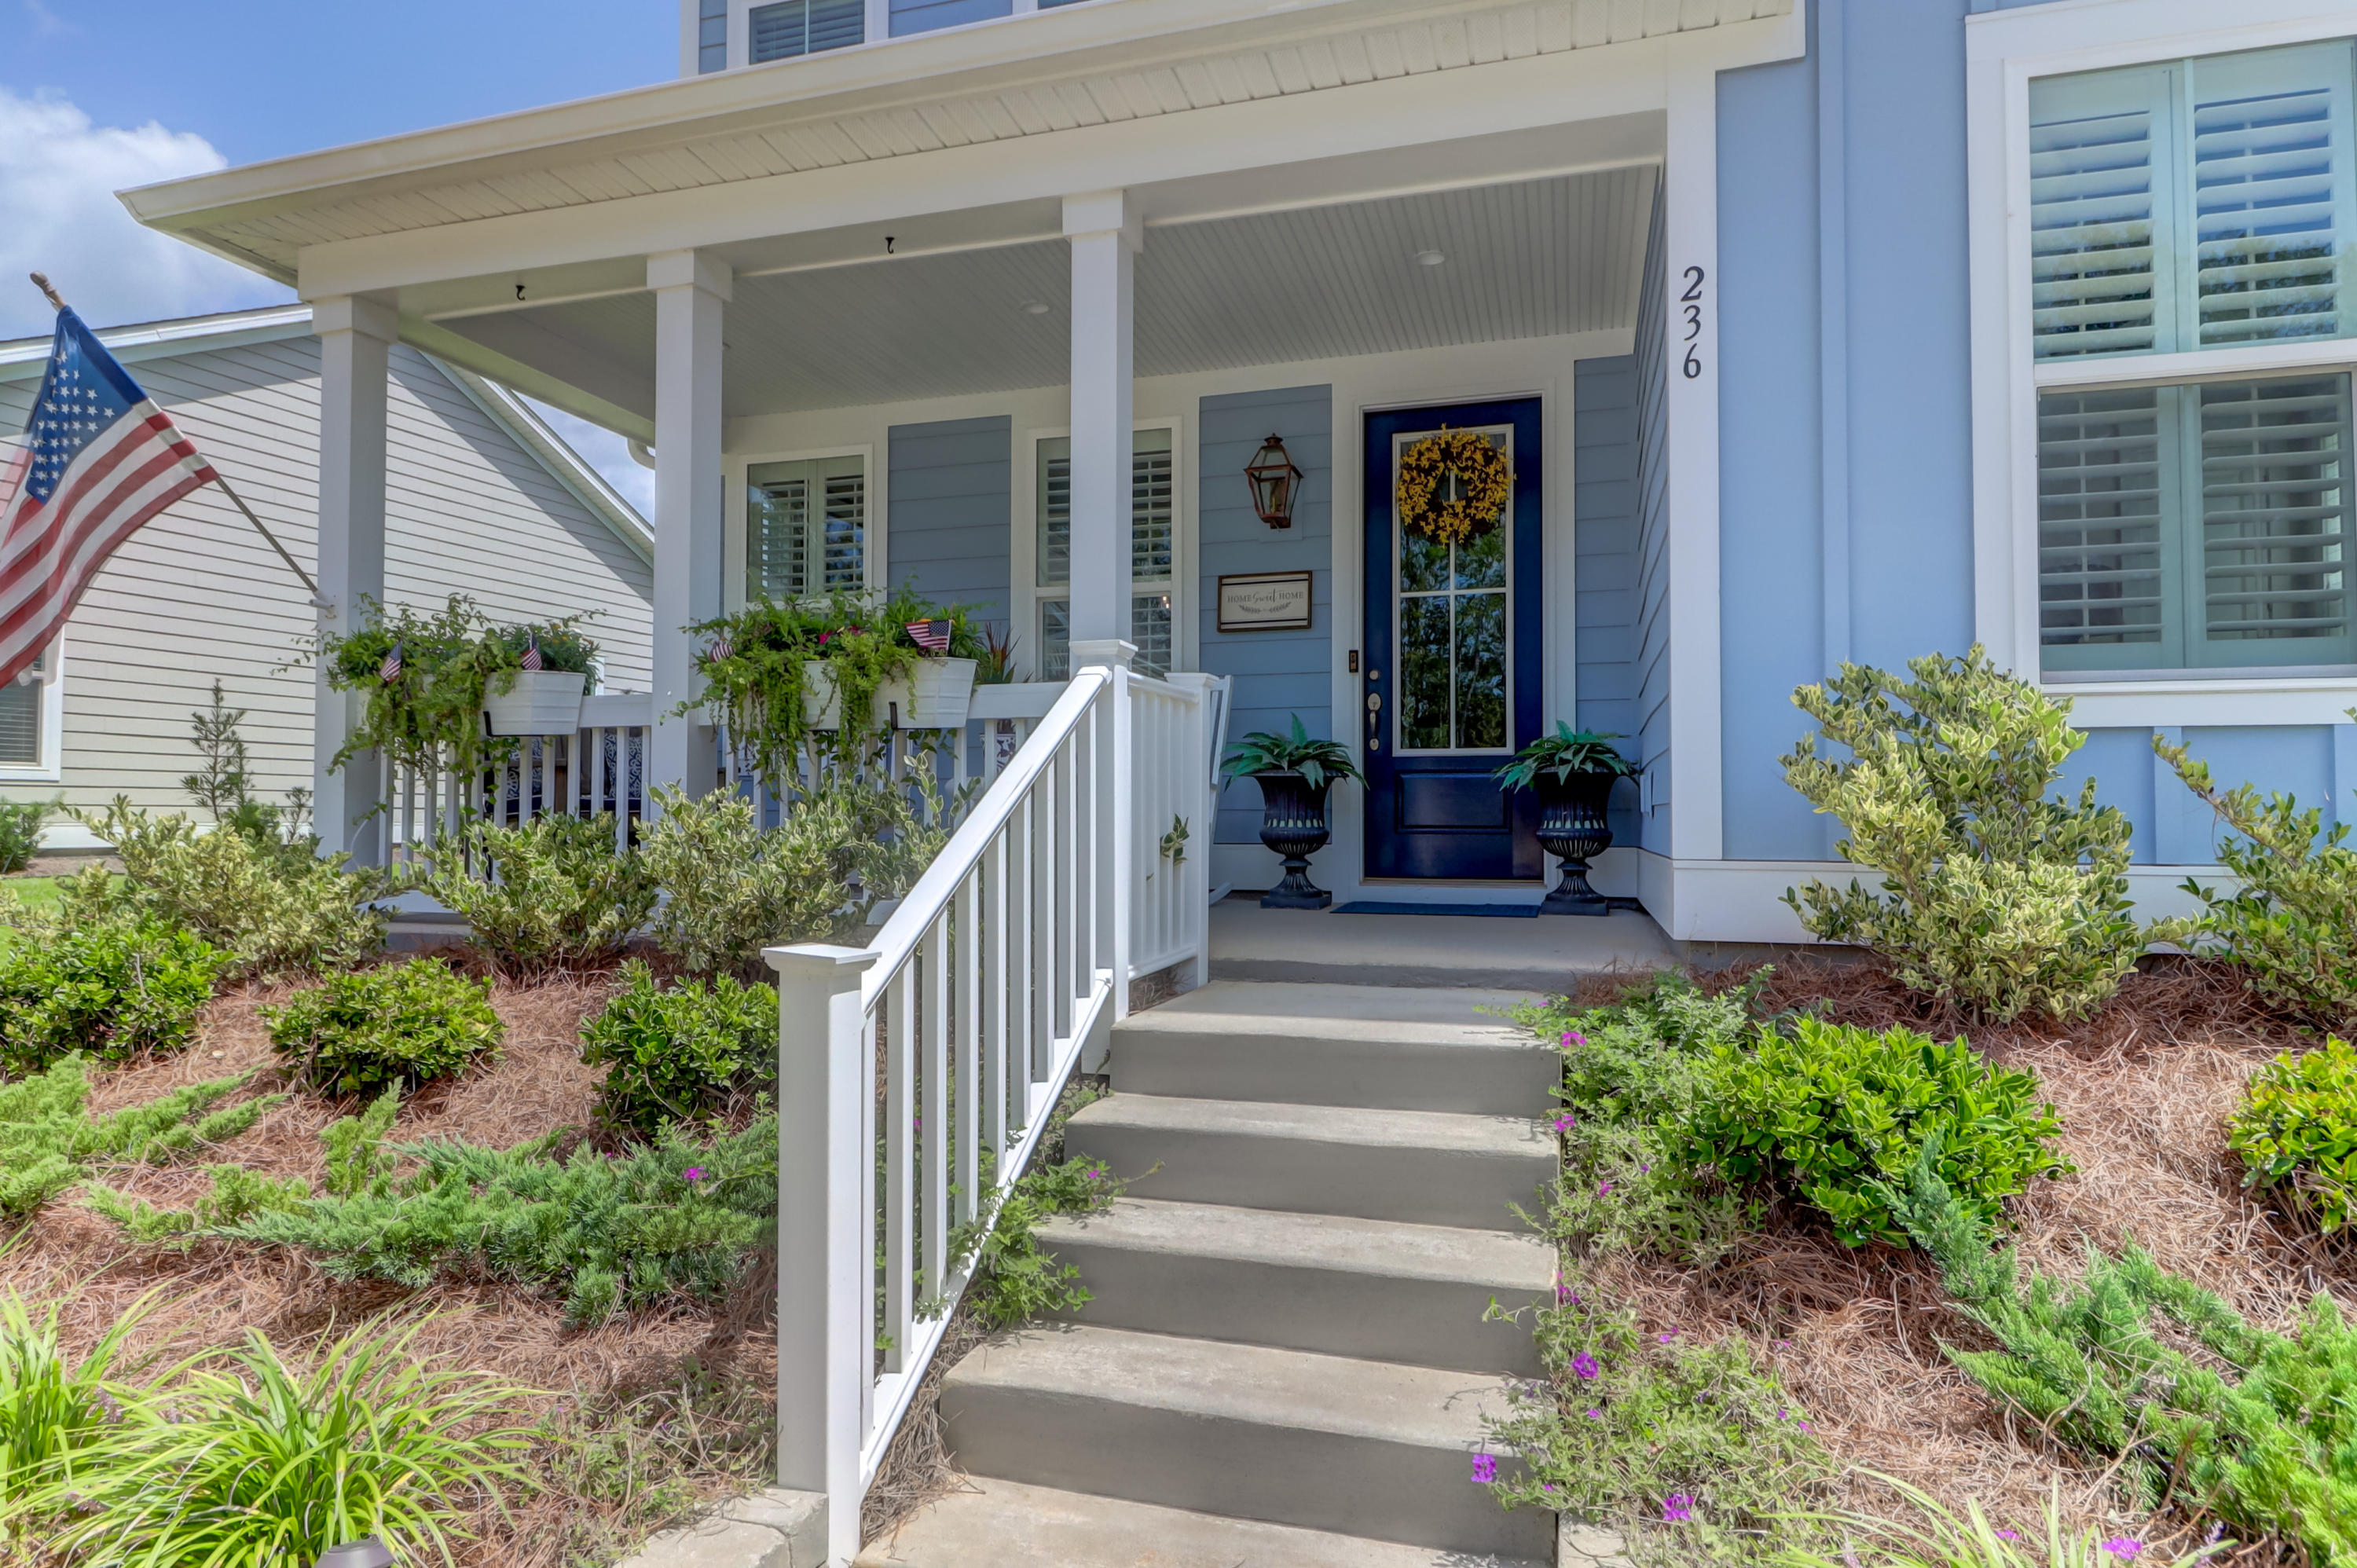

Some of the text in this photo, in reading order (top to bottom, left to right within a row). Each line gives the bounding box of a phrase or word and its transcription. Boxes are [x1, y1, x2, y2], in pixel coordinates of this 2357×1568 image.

[1680, 266, 1705, 379] 236
[1227, 595, 1252, 603] HOME
[1278, 591, 1304, 600] HOME
